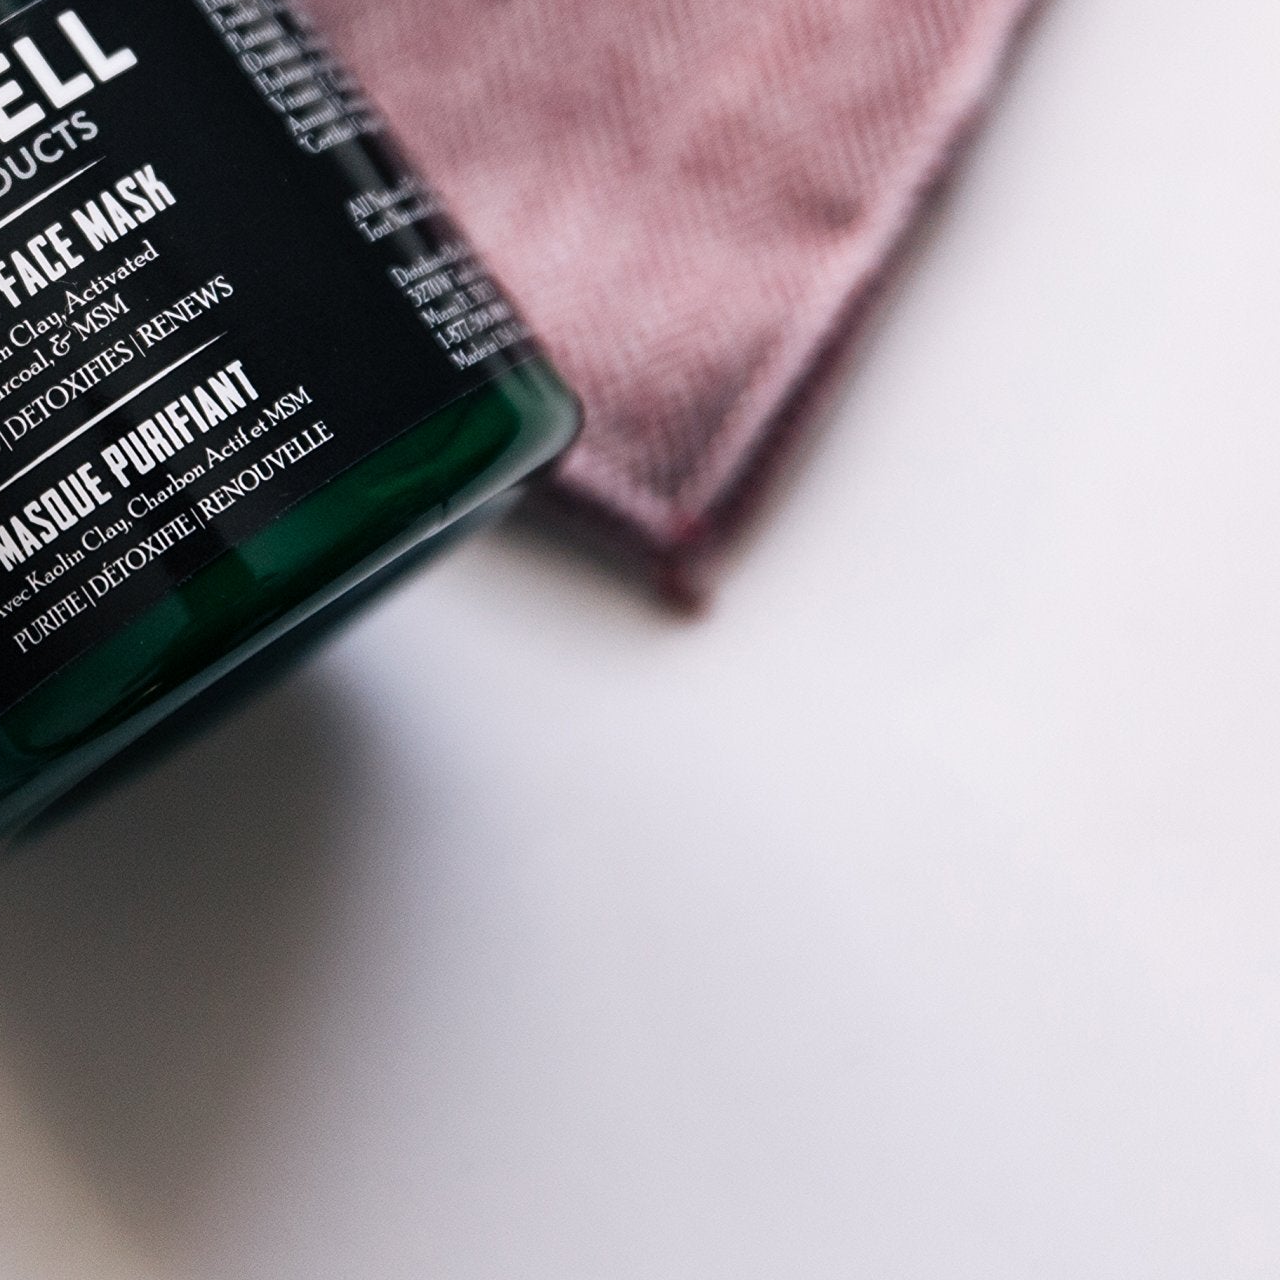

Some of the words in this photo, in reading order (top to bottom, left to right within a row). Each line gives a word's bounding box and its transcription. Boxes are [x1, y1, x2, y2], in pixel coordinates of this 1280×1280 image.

[71, 163, 177, 252] MASK
[4, 341, 135, 441] DETOXIFIES
[137, 275, 234, 348] RENEWS
[9, 309, 67, 349] Clay,
[64, 240, 160, 313] Activated
[49, 334, 72, 358] &
[71, 293, 130, 343] MSM
[100, 359, 260, 488] PURIFIANT
[13, 586, 88, 654] PURIFIE
[88, 513, 196, 598] DÉTOXIFIE
[197, 420, 335, 521] RENOUVELLE
[25, 548, 86, 595] Kaolin
[81, 515, 133, 552] Clay,
[127, 463, 207, 519] Charbon
[204, 428, 251, 469] Actif
[250, 416, 271, 439] et
[262, 386, 314, 428] MSM
